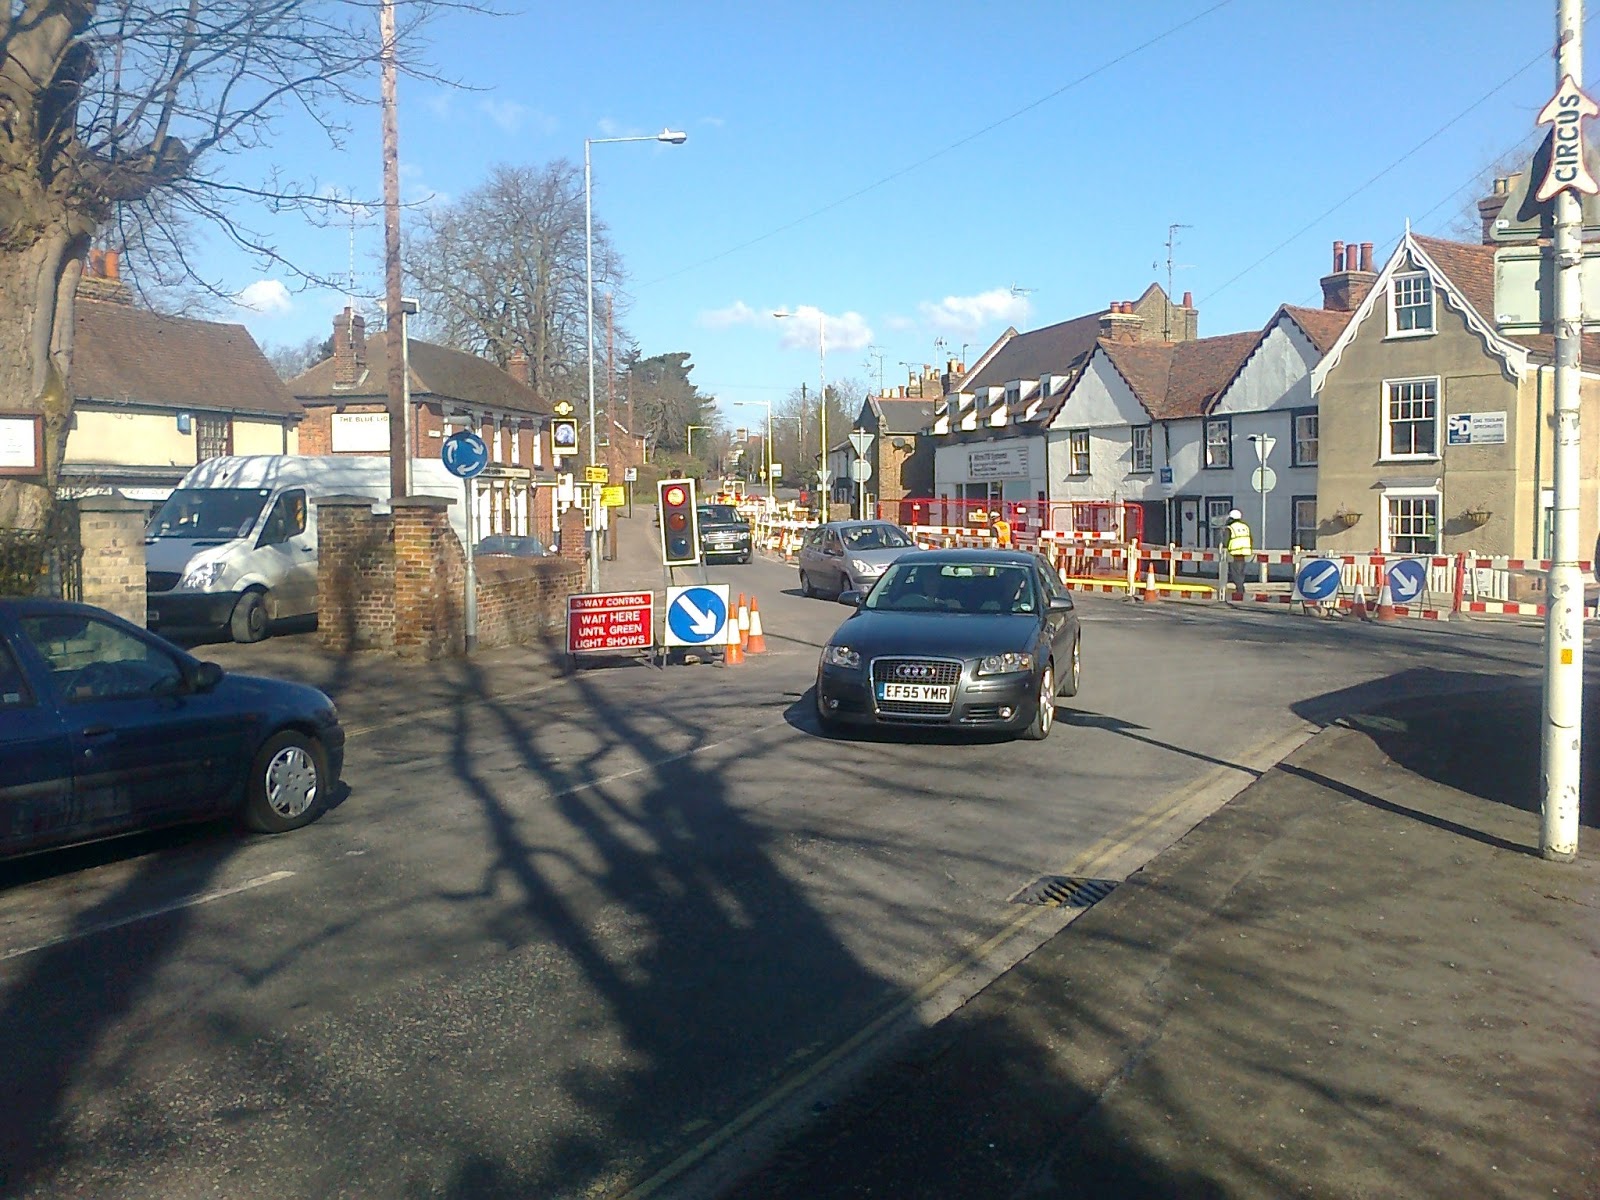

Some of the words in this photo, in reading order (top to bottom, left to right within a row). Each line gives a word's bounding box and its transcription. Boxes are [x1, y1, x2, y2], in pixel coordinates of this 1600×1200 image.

[1554, 94, 1580, 182] CIRCUS
[1449, 414, 1471, 436] SD
[605, 596, 645, 606] CONTROL
[581, 614, 607, 625] WAIT
[609, 610, 641, 623] HERE
[579, 626, 606, 637] UNTIL
[609, 623, 642, 635] GREEN
[575, 638, 603, 649] LIGHT
[606, 634, 645, 647] SHOWS
[922, 687, 948, 700] YMR
